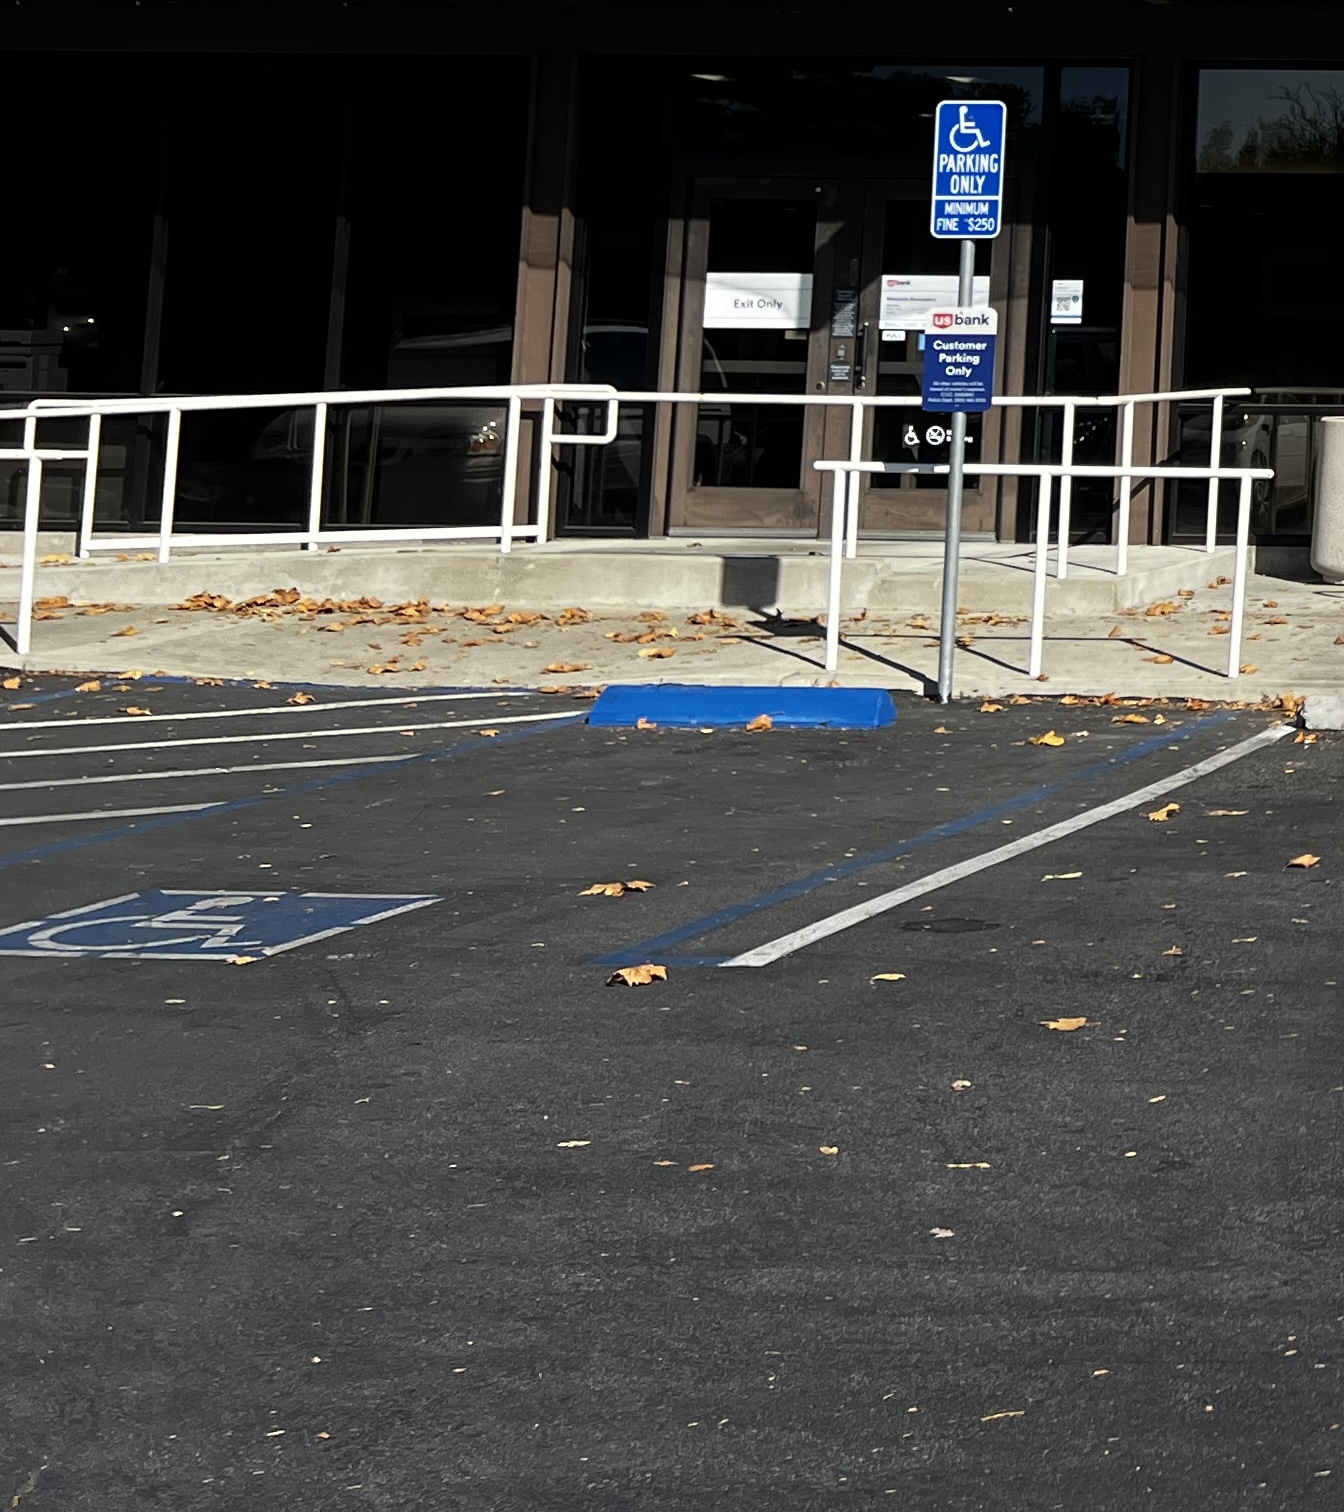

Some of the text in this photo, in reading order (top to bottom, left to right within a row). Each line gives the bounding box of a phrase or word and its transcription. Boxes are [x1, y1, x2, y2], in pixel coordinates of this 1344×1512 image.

[939, 153, 999, 173] PARKING
[950, 175, 986, 194] ONLY
[944, 202, 990, 215] MINIMUM
[936, 218, 995, 231] FINE $250
[734, 299, 783, 310] Exit Only
[954, 314, 989, 325] bank
[933, 340, 987, 350] Customer
[939, 353, 980, 365] Parking
[945, 366, 972, 377] Only
